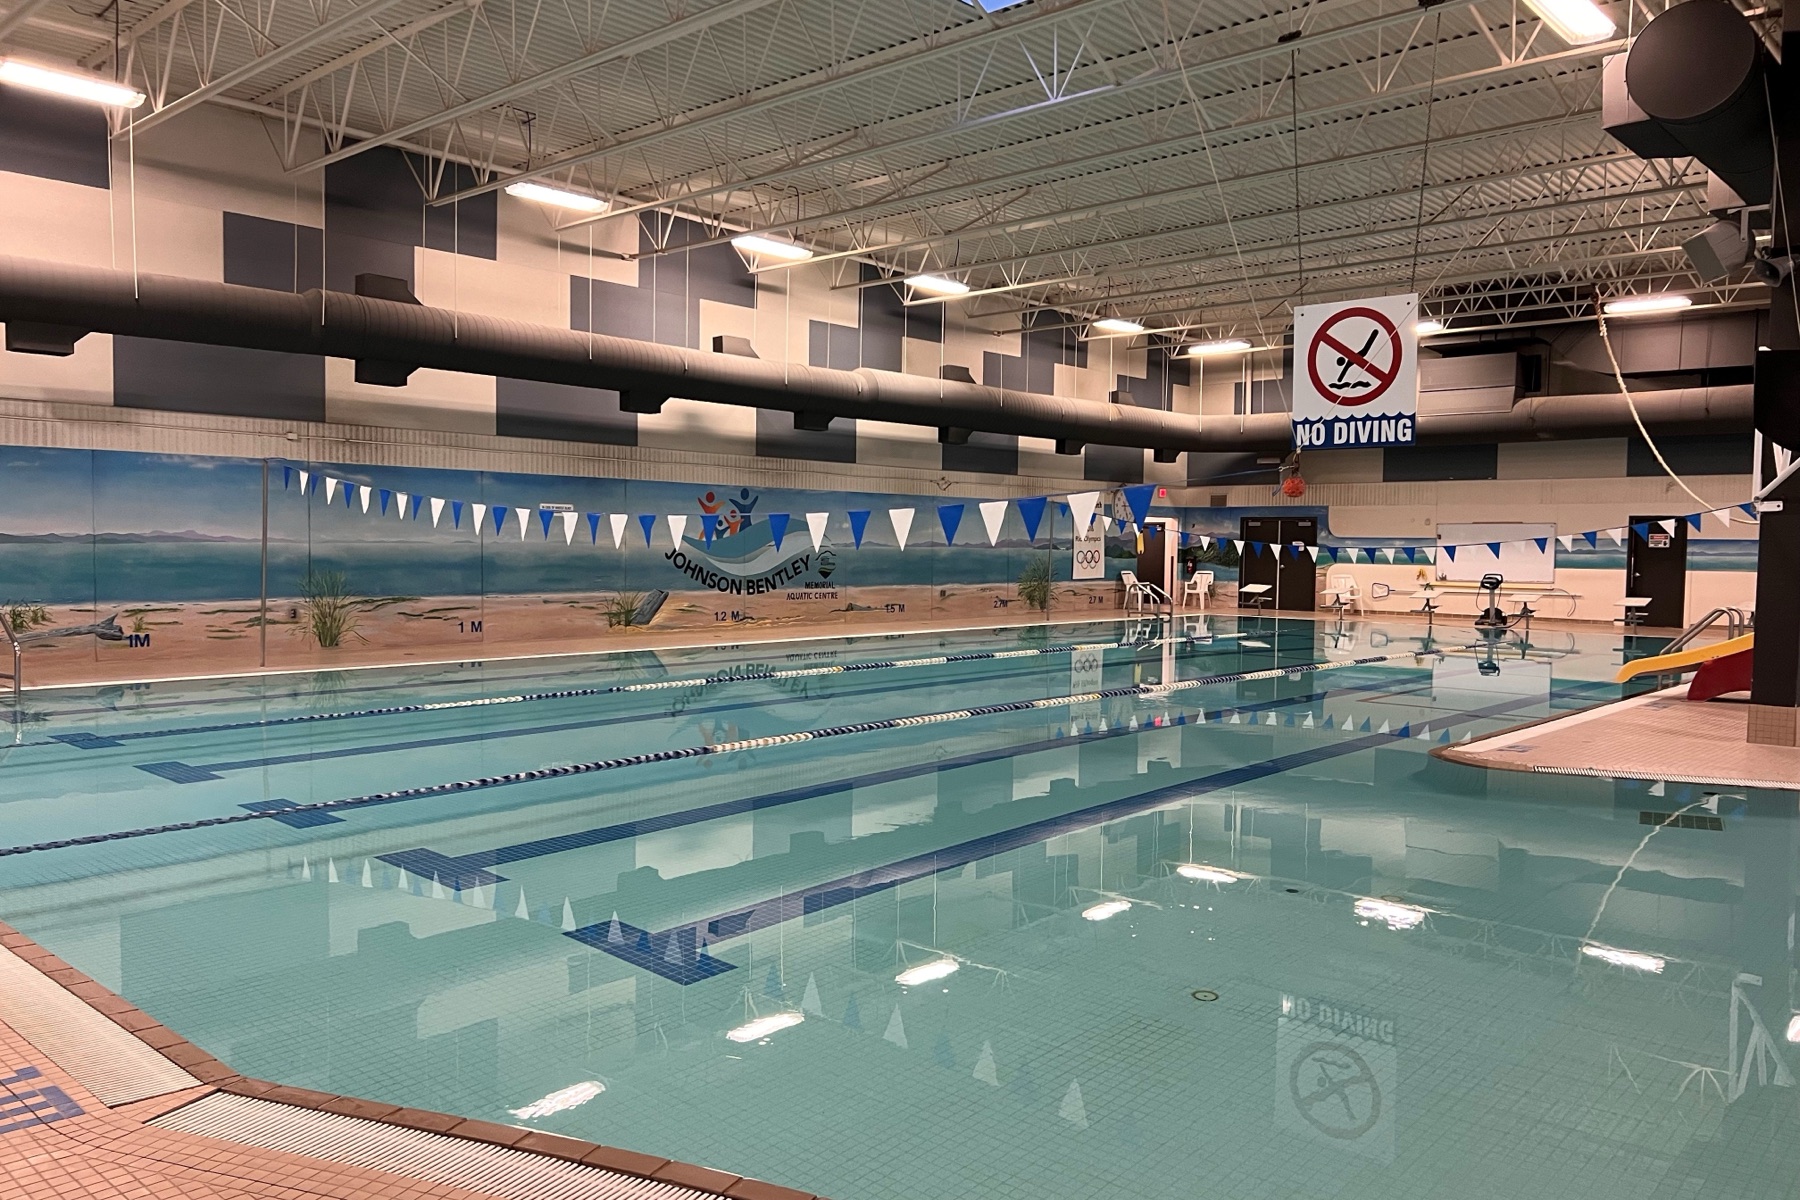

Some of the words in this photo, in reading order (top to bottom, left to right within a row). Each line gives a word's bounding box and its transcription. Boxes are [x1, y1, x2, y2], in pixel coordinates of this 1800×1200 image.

[1296, 422, 1326, 446] NO
[1333, 418, 1412, 445] DIVING
[664, 548, 742, 596] JOHNSON
[746, 554, 811, 596] BENTLEY
[804, 581, 836, 590] MEMORIAL
[786, 592, 813, 601] AQUATIC
[814, 591, 839, 600] CENTRE
[731, 610, 740, 621] M
